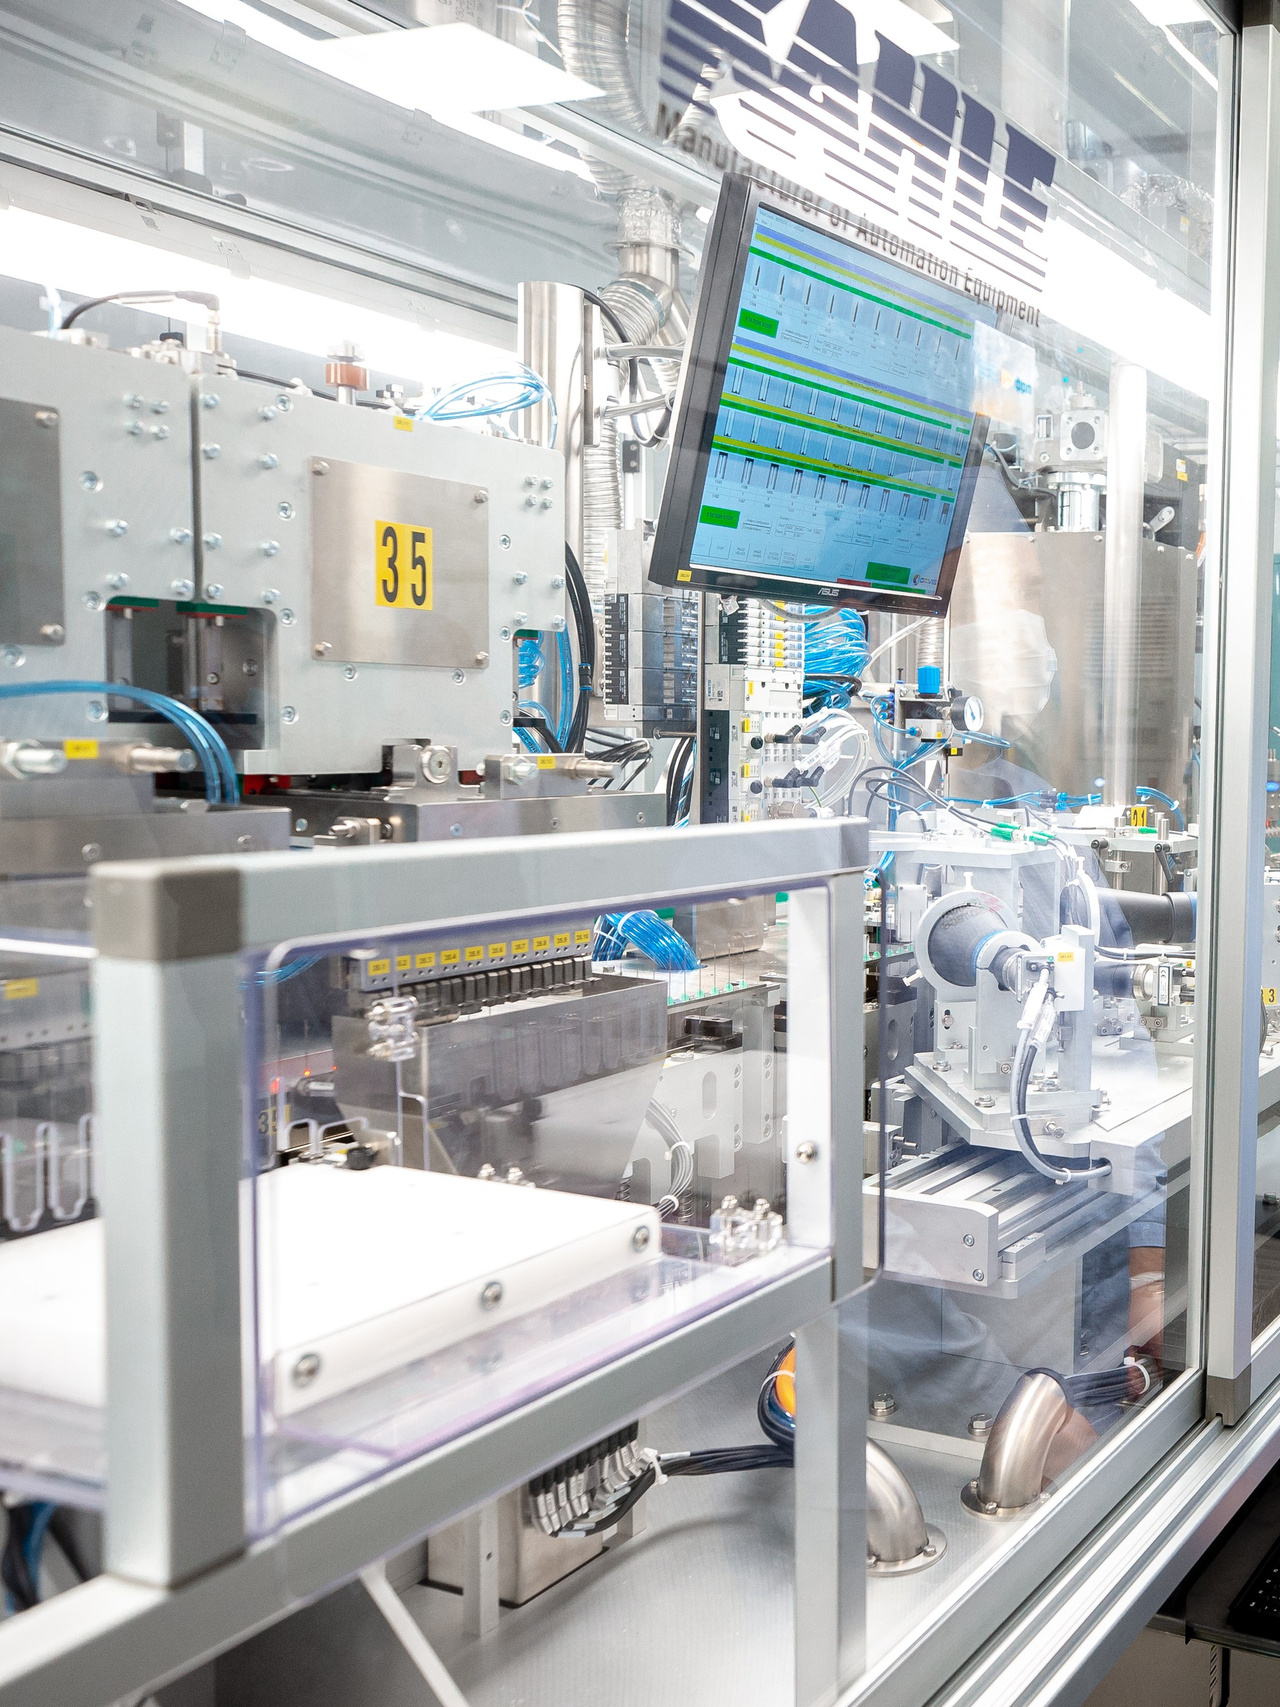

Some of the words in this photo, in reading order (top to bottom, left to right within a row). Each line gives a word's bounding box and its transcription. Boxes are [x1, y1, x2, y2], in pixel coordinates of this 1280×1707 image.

[856, 212, 959, 287] Automation
[964, 267, 1041, 328] Equipment
[380, 524, 428, 607] 35
